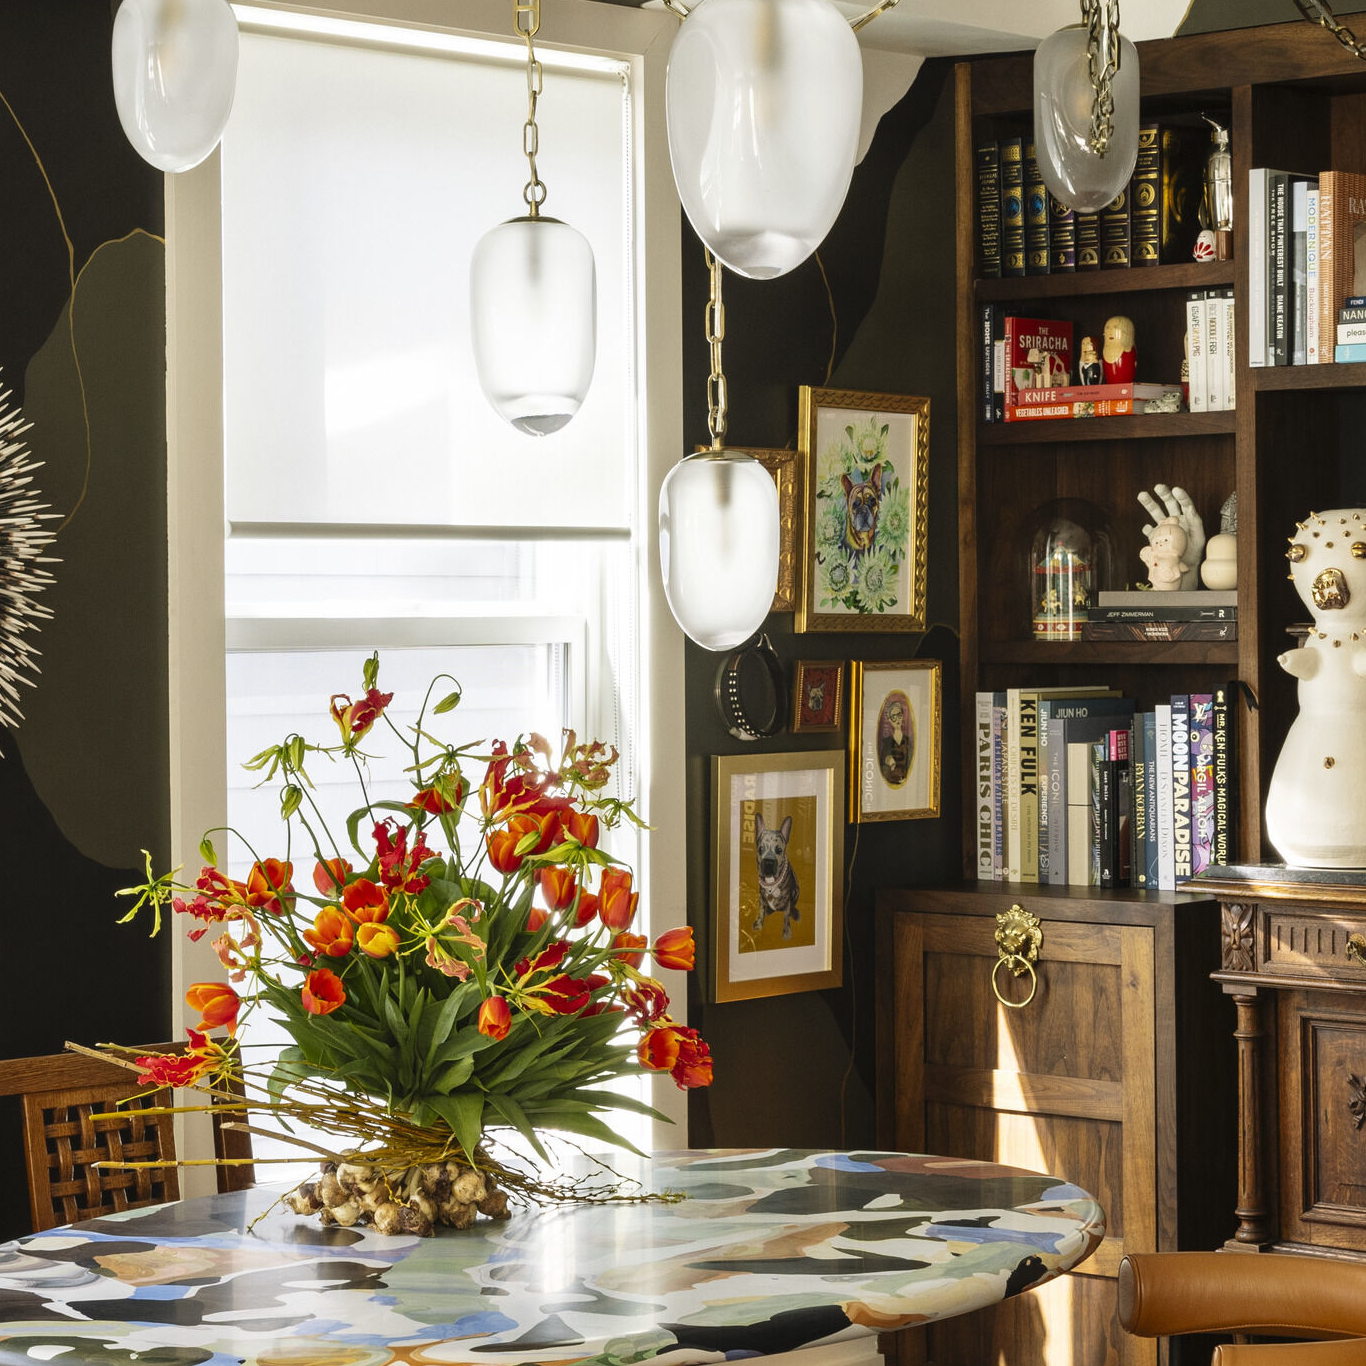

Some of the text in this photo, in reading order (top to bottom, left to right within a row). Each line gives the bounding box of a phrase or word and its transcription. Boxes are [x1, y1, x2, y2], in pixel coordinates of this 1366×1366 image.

[1308, 198, 1316, 277] MODERNIQUE
[1320, 196, 1331, 260] RATTAN
[1039, 327, 1049, 335] THE
[1276, 315, 1284, 339] KEATON
[1019, 335, 1068, 350] SRIRACHA
[1025, 391, 1056, 402] KNIFE
[1015, 406, 1069, 417] VEGETABLES UNLEASHED
[1056, 708, 1088, 718] JIUN HO
[1217, 714, 1225, 728] MR.
[1020, 699, 1036, 795] KEN FULK
[1041, 732, 1047, 746] HO
[979, 723, 991, 866] PARIS CHIC
[995, 782, 1003, 822] PAINTED
[1135, 763, 1145, 839] RYAN KORBAN
[1197, 795, 1207, 838] ABLOH
